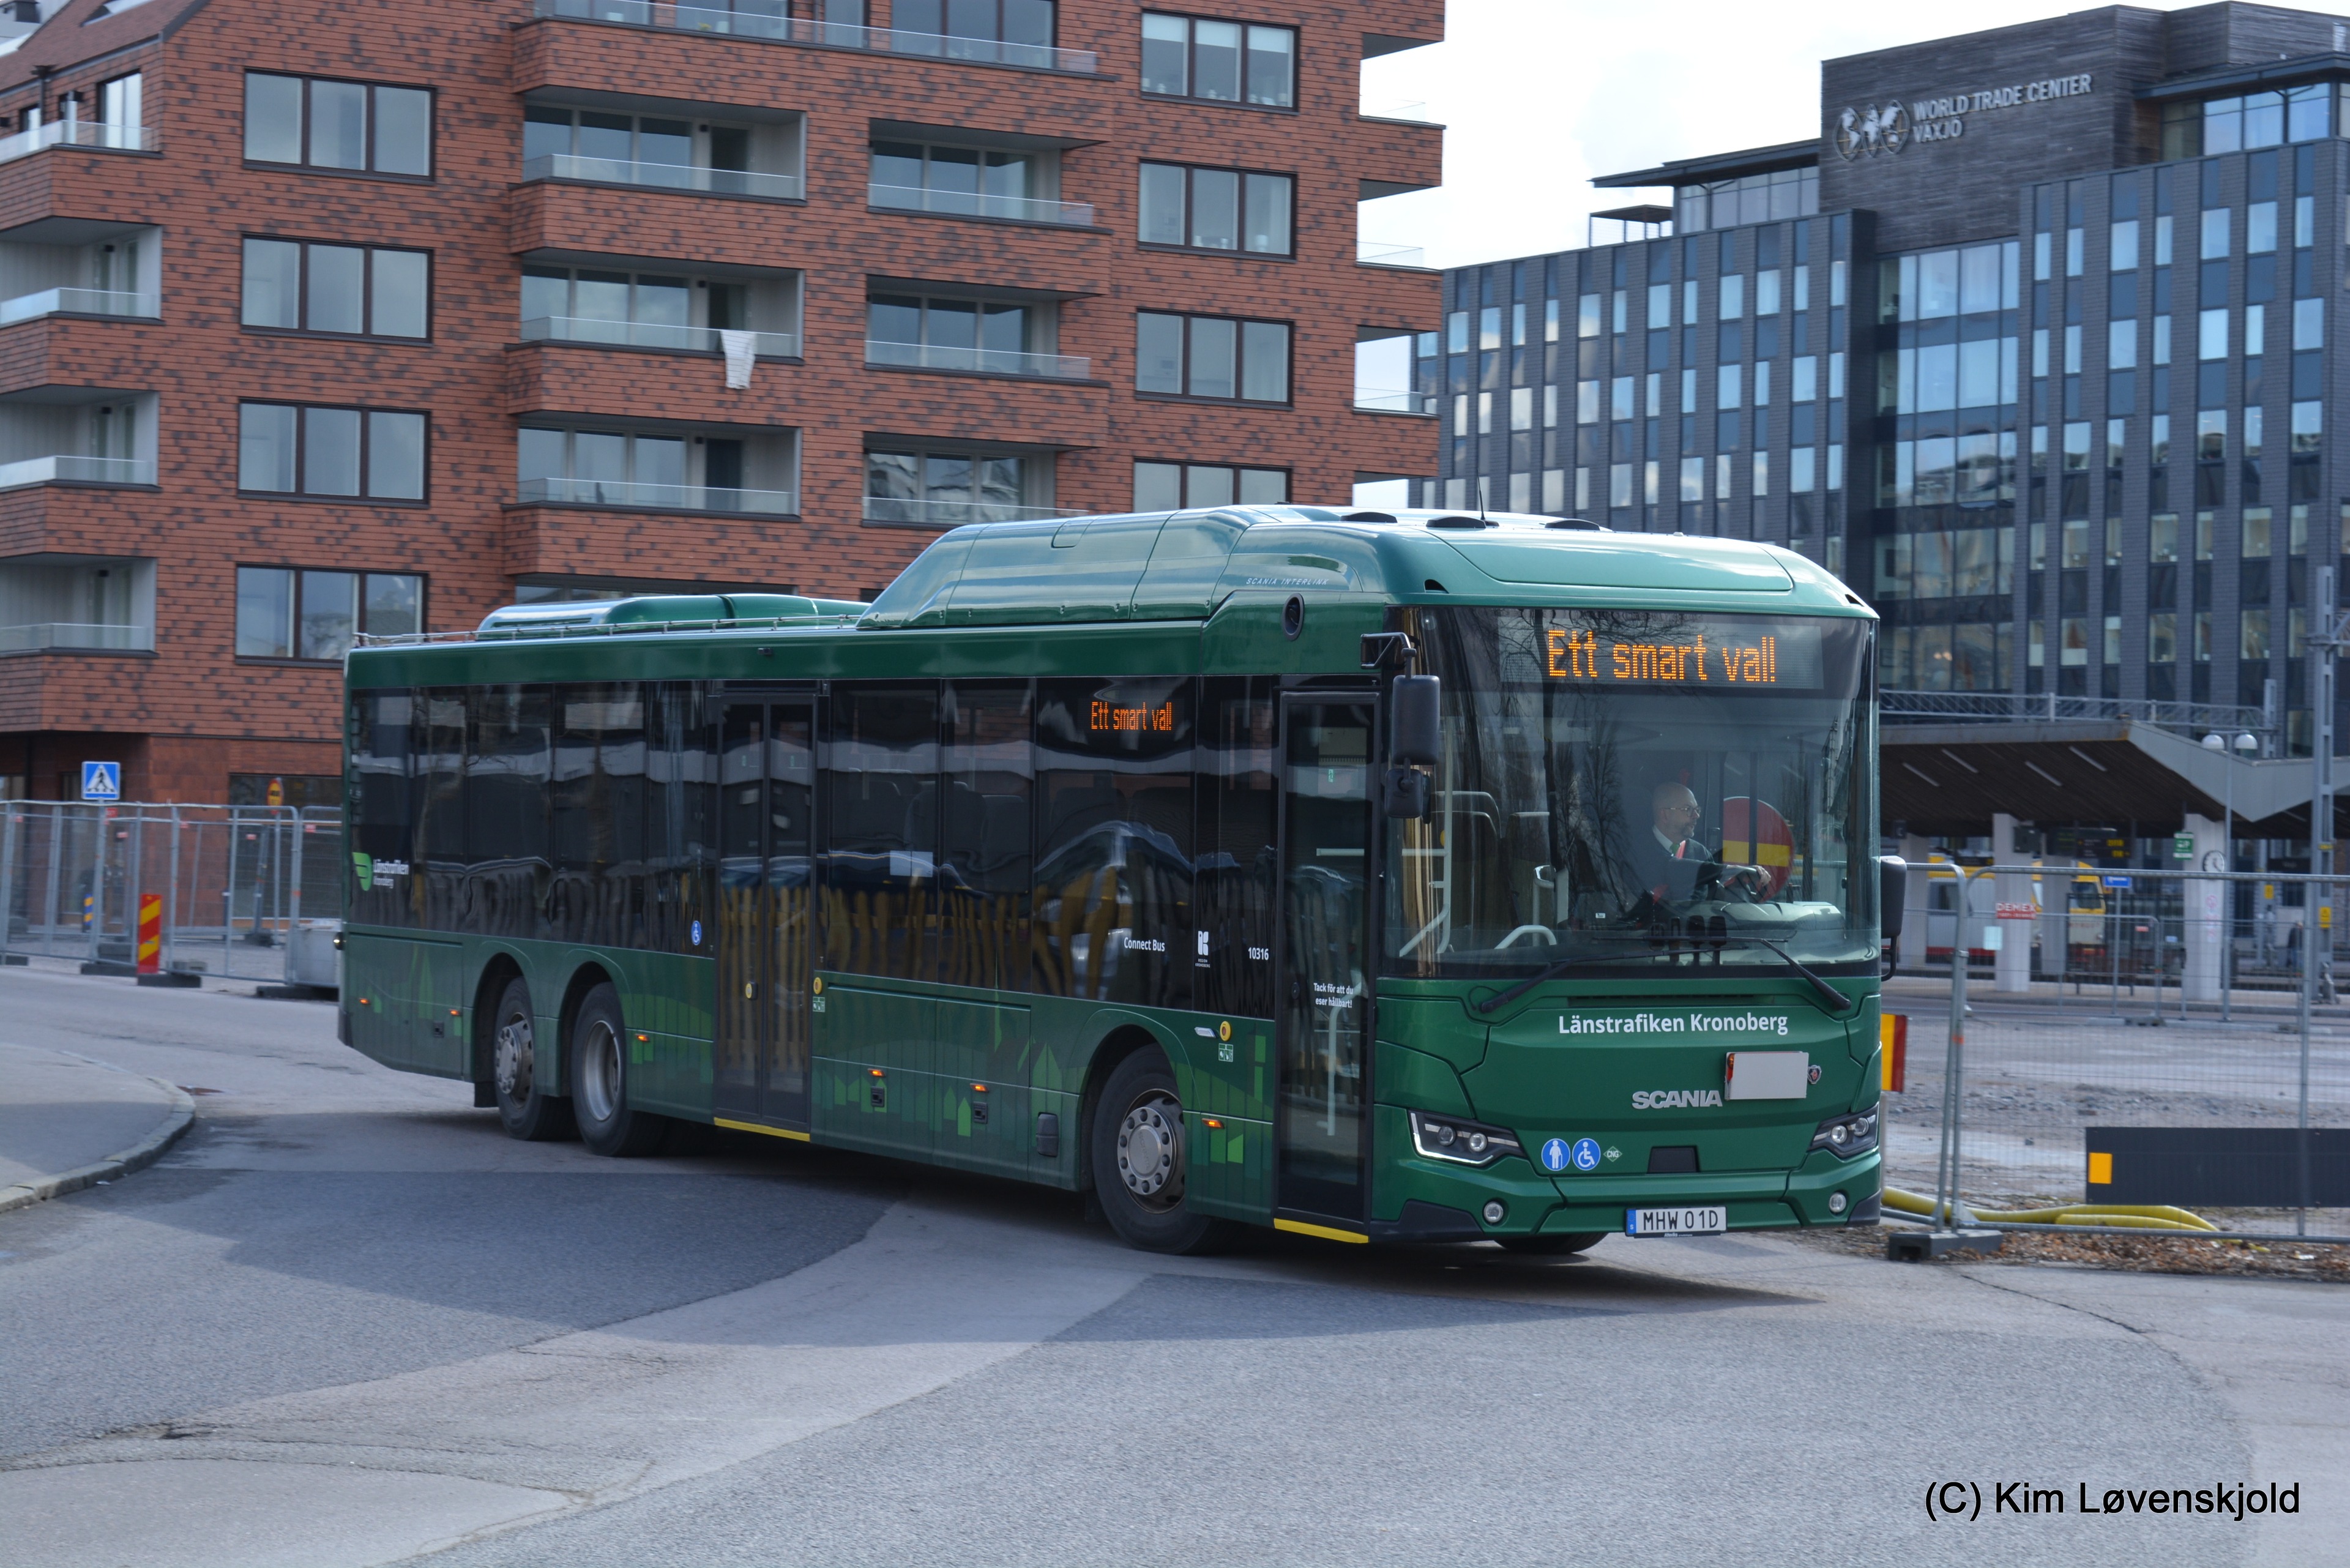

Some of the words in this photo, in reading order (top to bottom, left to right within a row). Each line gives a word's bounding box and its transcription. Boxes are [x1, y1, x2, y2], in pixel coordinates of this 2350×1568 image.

[1914, 95, 1968, 121] WORLD
[1972, 85, 2023, 111] TRADE
[2027, 73, 2092, 102] CENTER
[1913, 117, 1963, 143] VÄXJÖ
[1548, 630, 1598, 678] Ett
[1613, 634, 1707, 681] smart
[1722, 636, 1776, 682] val!
[1091, 701, 1109, 730] Ett
[1113, 702, 1147, 730] smart
[1151, 702, 1173, 730] val!
[1124, 936, 1152, 950] Connect
[1152, 939, 1165, 952] Bus
[1248, 947, 1269, 961] 10316
[1313, 983, 1326, 992] Tack
[1327, 984, 1335, 993] för
[1336, 985, 1345, 994] att
[1346, 985, 1354, 995] du
[1328, 996, 1352, 1008] hållbart!
[1559, 1013, 1684, 1034] Länstrafiken
[1690, 1012, 1788, 1035] Kronoberg
[1632, 1090, 1723, 1109] SCANIA
[1643, 1211, 1678, 1231] MHW
